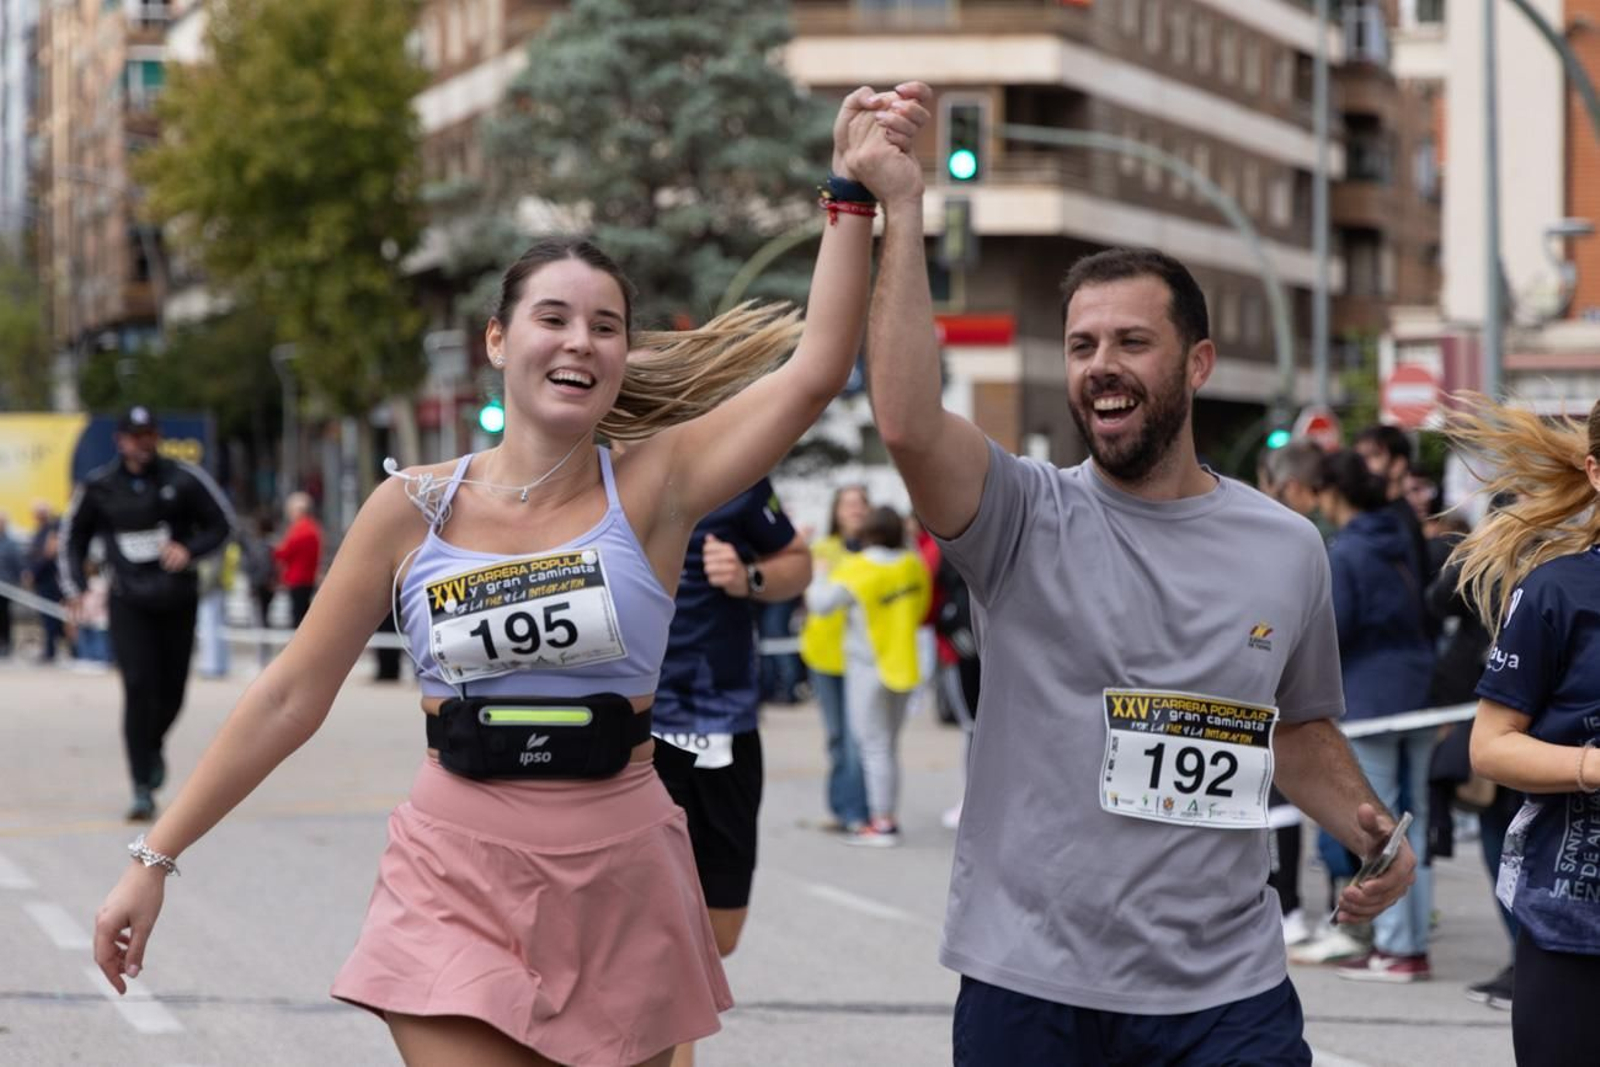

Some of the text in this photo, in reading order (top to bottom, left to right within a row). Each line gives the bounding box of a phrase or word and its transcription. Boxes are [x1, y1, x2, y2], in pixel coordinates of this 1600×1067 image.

[467, 555, 588, 586] CARRERA POPULA
[469, 563, 596, 599] y gran caminata
[432, 578, 467, 610] XXV
[470, 601, 578, 661] 195
[1112, 697, 1150, 720] XXV
[1152, 698, 1268, 721] CARRERA POPULAR
[1152, 709, 1266, 732] y gran caminata
[1143, 742, 1239, 798] 192
[1559, 819, 1585, 873] SANTA
[1580, 852, 1599, 878] DE
